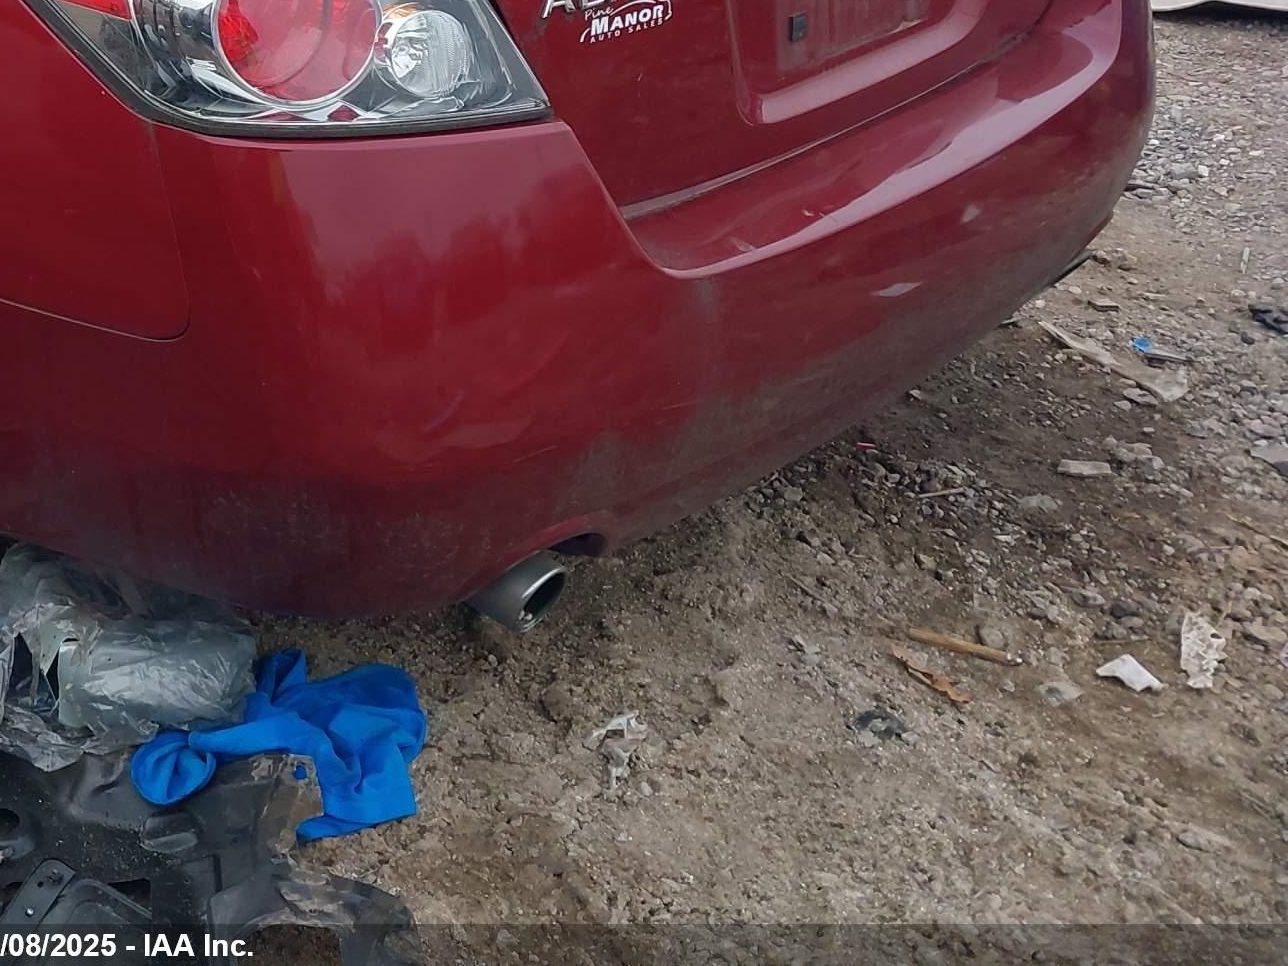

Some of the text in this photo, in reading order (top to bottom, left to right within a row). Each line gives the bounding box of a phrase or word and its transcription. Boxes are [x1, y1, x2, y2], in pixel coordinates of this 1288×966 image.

[585, 6, 614, 21] Pine
[589, 4, 664, 37] MANOR
[590, 17, 663, 44] AUTO SALES
